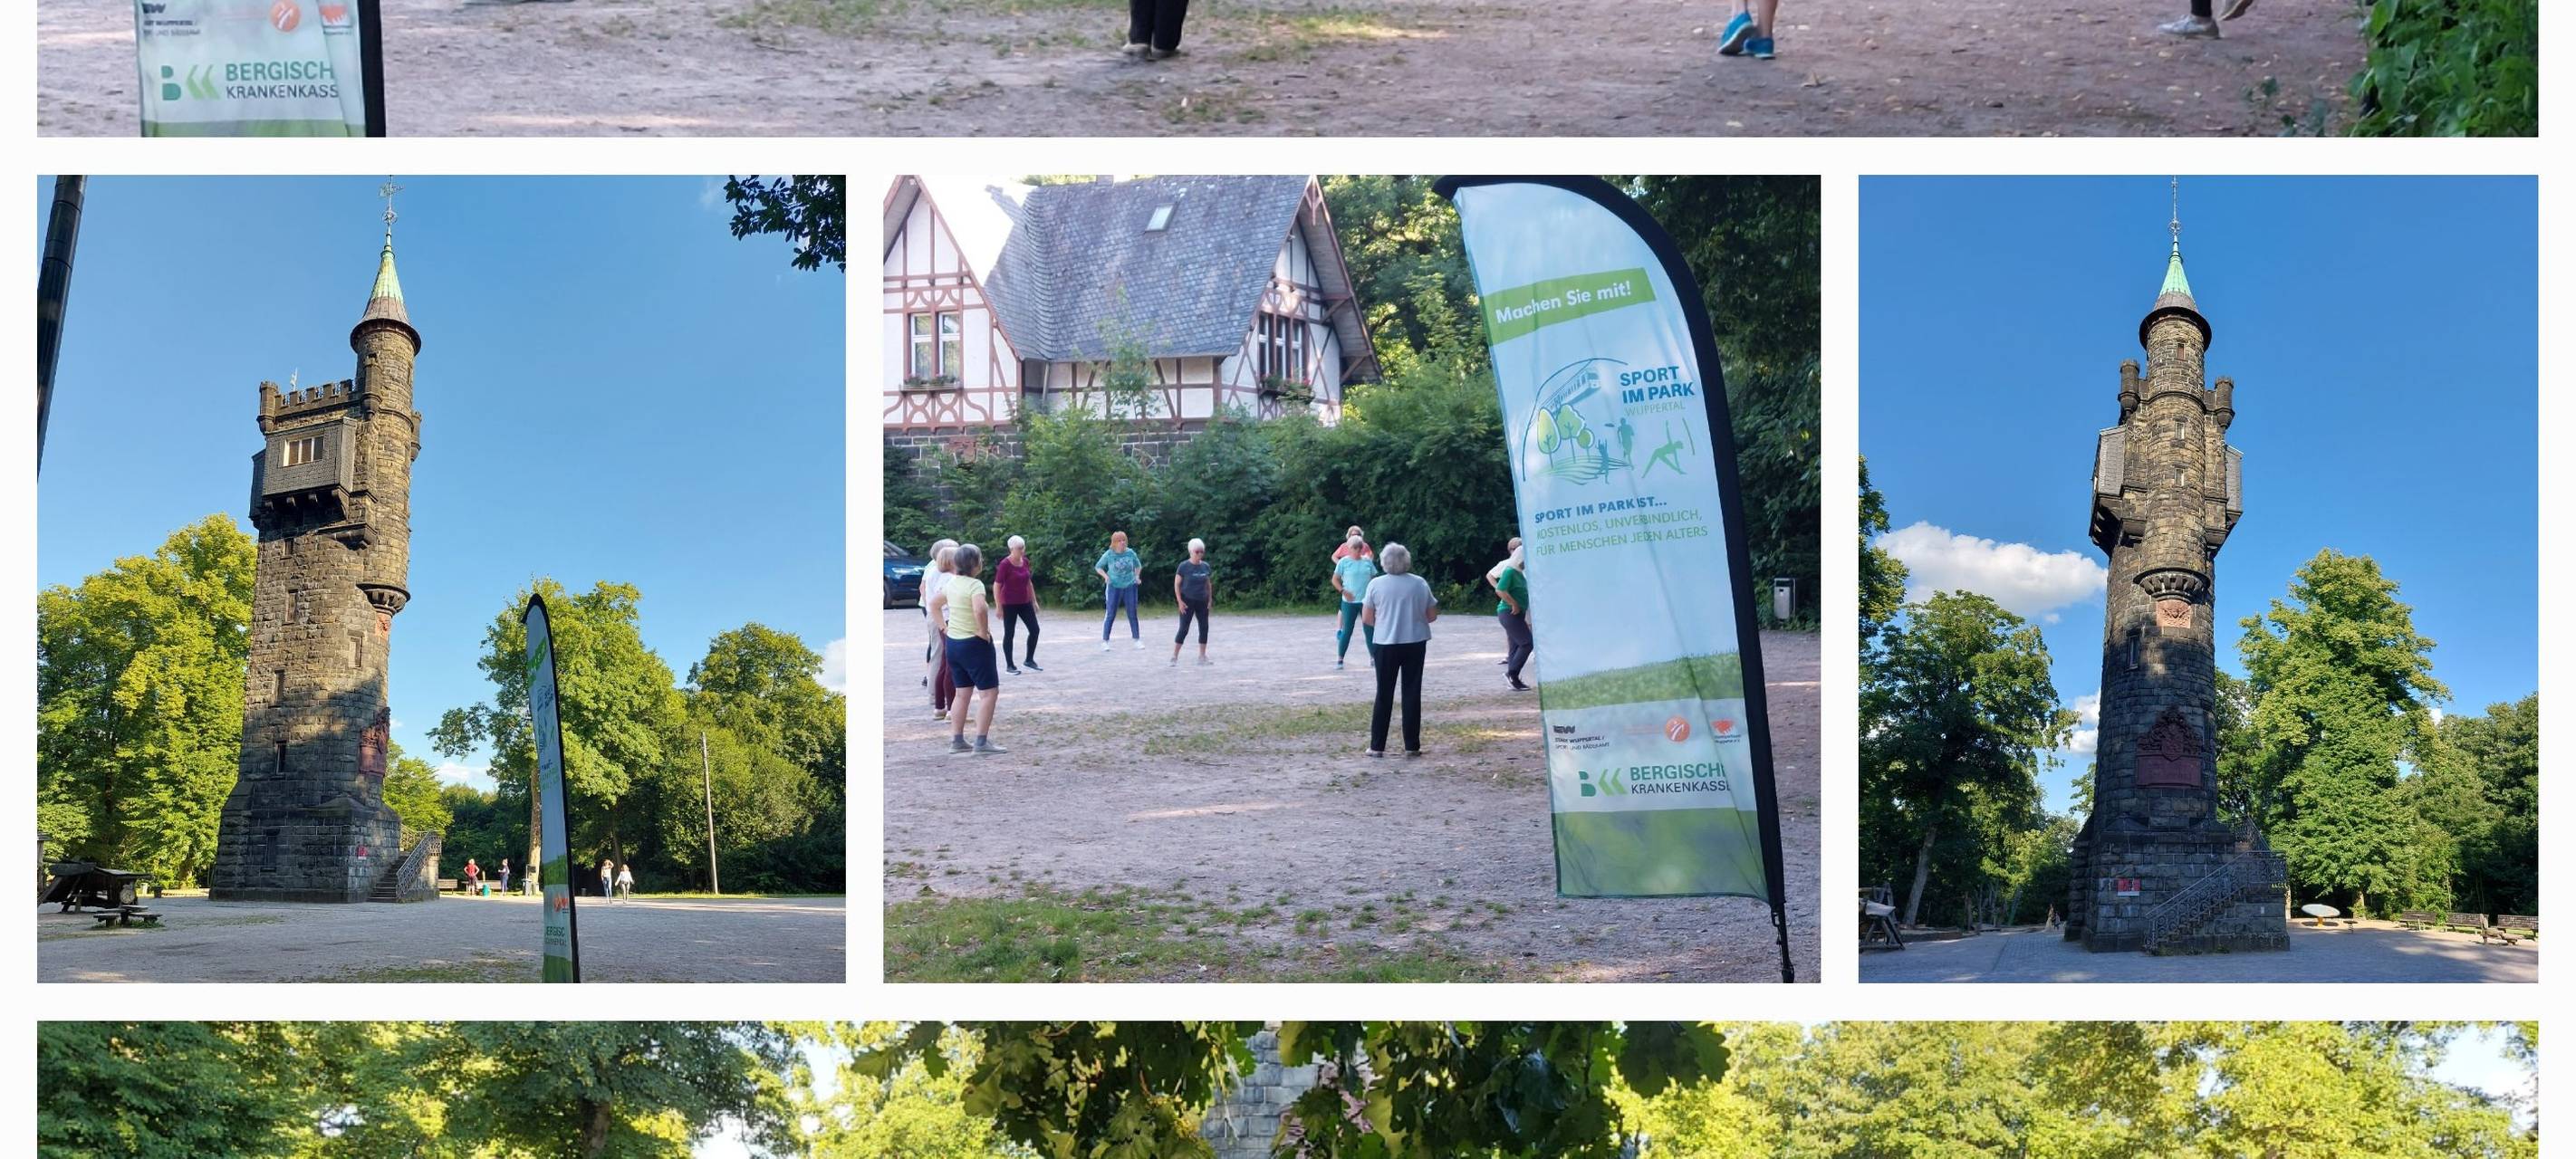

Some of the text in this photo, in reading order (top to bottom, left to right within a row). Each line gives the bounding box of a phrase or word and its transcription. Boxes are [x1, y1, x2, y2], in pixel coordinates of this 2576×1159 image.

[1495, 281, 1631, 323] Machen Sie mit!
[1620, 366, 1679, 387] SPORT
[1622, 382, 1696, 404] IM PARK
[1624, 400, 1686, 417] WUPPERTAL
[1534, 507, 1572, 523] SPORT
[1576, 503, 1594, 516] IM
[1599, 497, 1636, 513] PARK
[1560, 532, 1628, 553] MENSCHEN
[1630, 530, 1663, 543] JEDEN
[1666, 526, 1708, 540] ALTERS
[1630, 762, 1725, 781] BERGISCH
